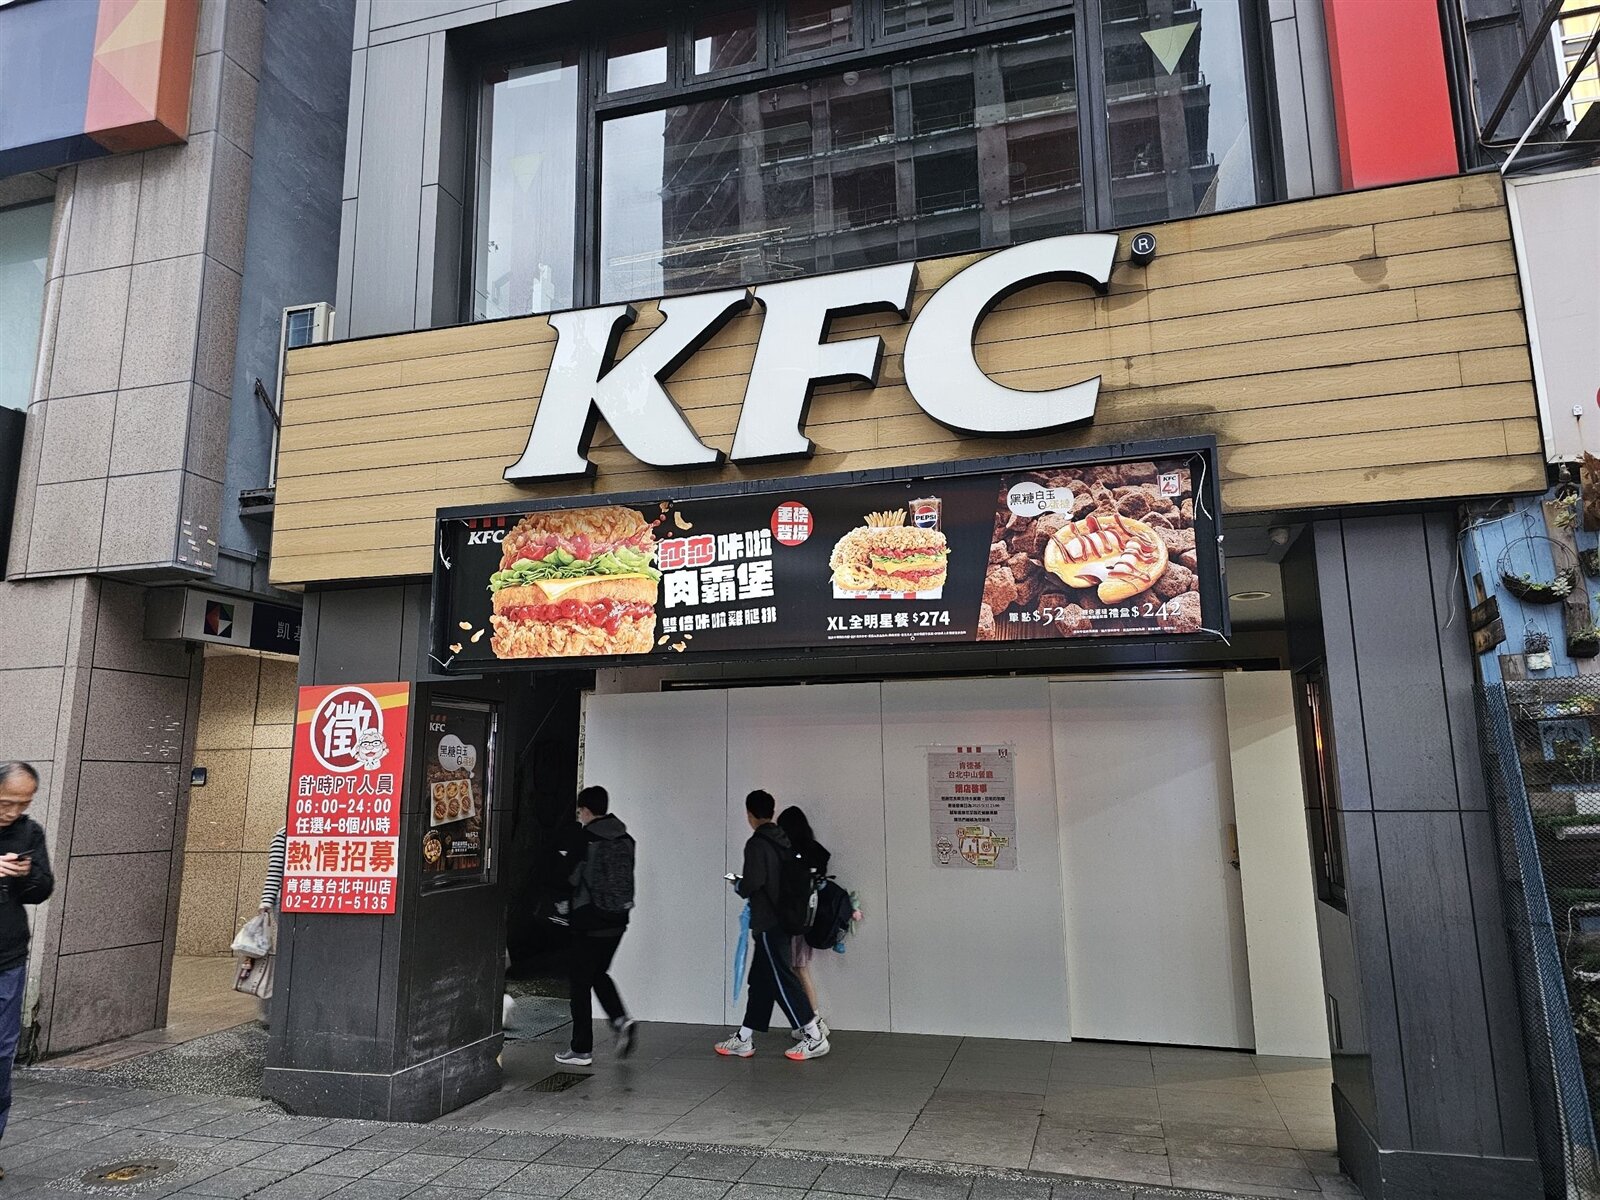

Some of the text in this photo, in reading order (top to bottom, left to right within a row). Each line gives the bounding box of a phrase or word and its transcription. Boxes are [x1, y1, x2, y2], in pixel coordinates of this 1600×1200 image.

[503, 233, 1119, 484] KFC
[915, 514, 937, 522] PEPSI
[467, 529, 505, 545] KFC
[663, 560, 775, 609] 肉霸堡
[912, 610, 951, 627] $274
[322, 700, 372, 759] 徵
[429, 722, 446, 732] KFC
[295, 798, 392, 814] 06:00-24:00
[295, 816, 391, 835] 任選4-8個小時
[286, 839, 395, 873] 熱情招募
[286, 878, 392, 895] 肯德基台北中山店
[285, 895, 388, 910] 02-2771-5135
